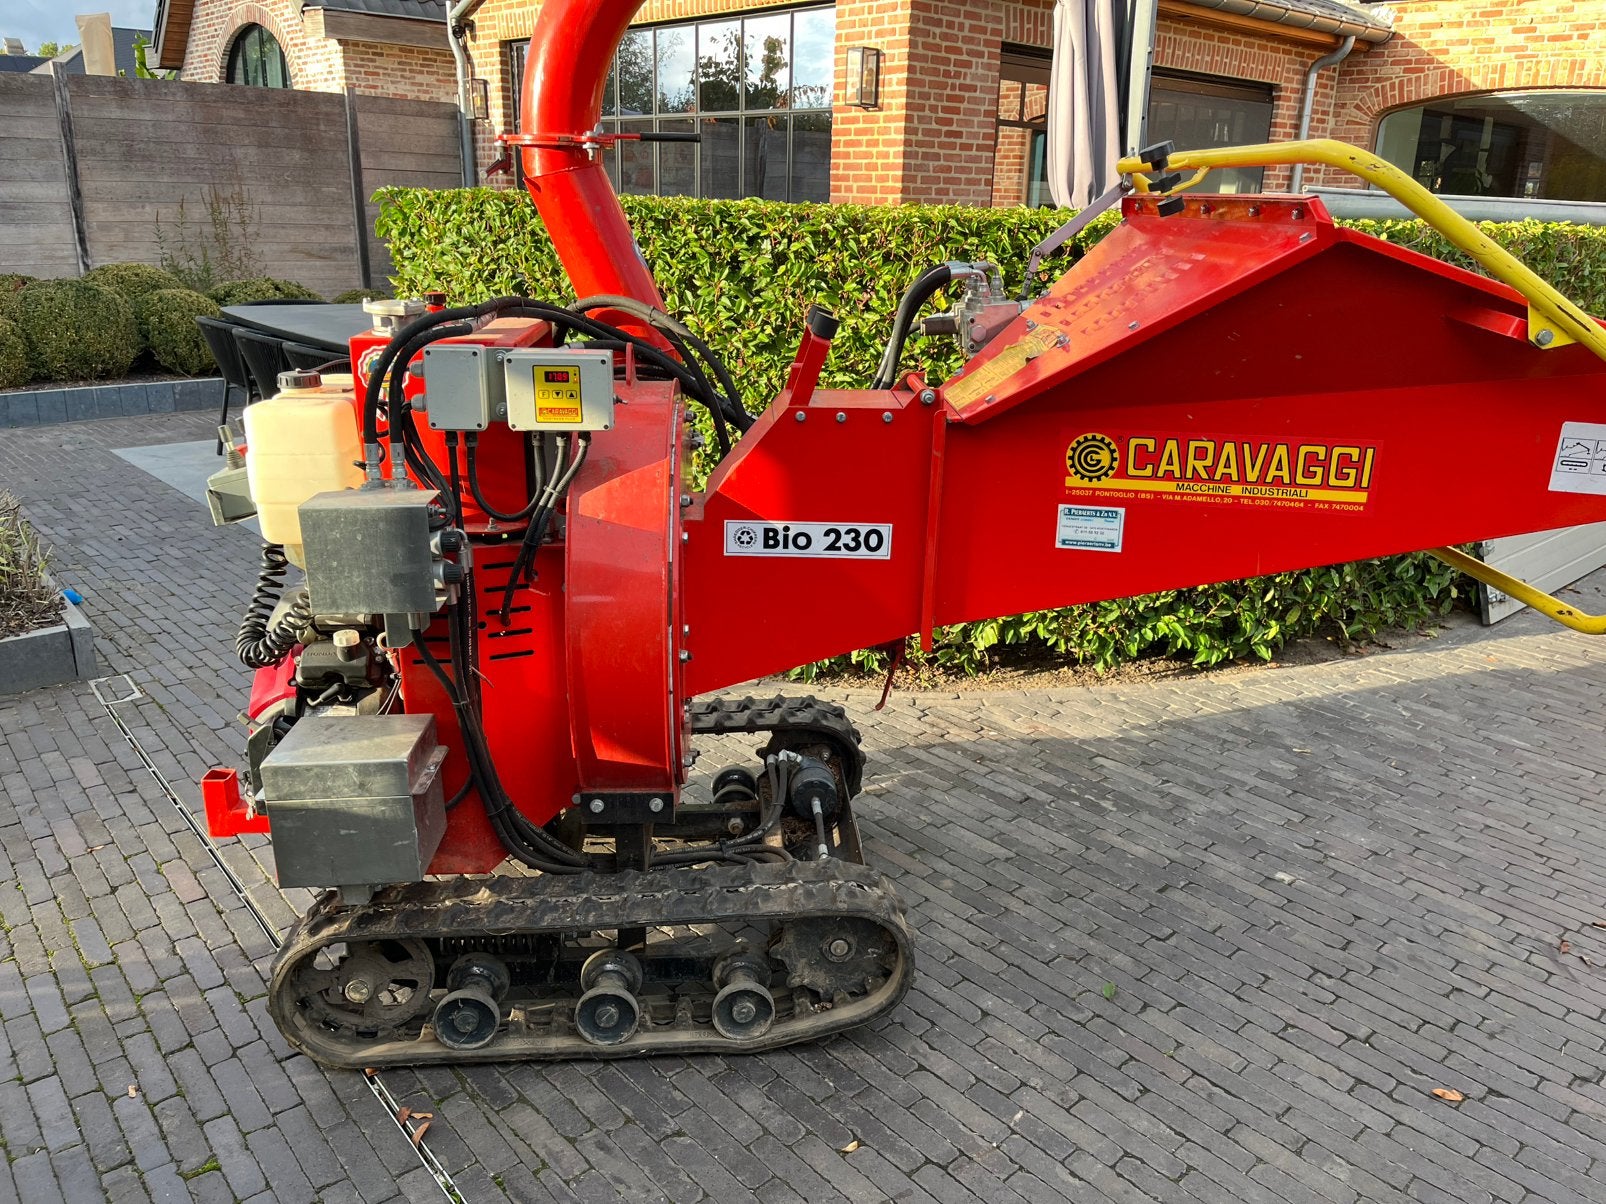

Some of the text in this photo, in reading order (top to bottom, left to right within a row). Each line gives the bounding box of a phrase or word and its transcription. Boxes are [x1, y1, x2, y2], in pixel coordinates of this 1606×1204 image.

[1127, 437, 1376, 488] CARAVAGGI
[1095, 490, 1135, 498] PONTOGLIO
[1331, 503, 1364, 511] 7470004
[1175, 483, 1309, 498] MACCHINE INDUSTRIALI
[763, 525, 884, 553] Bio 230
